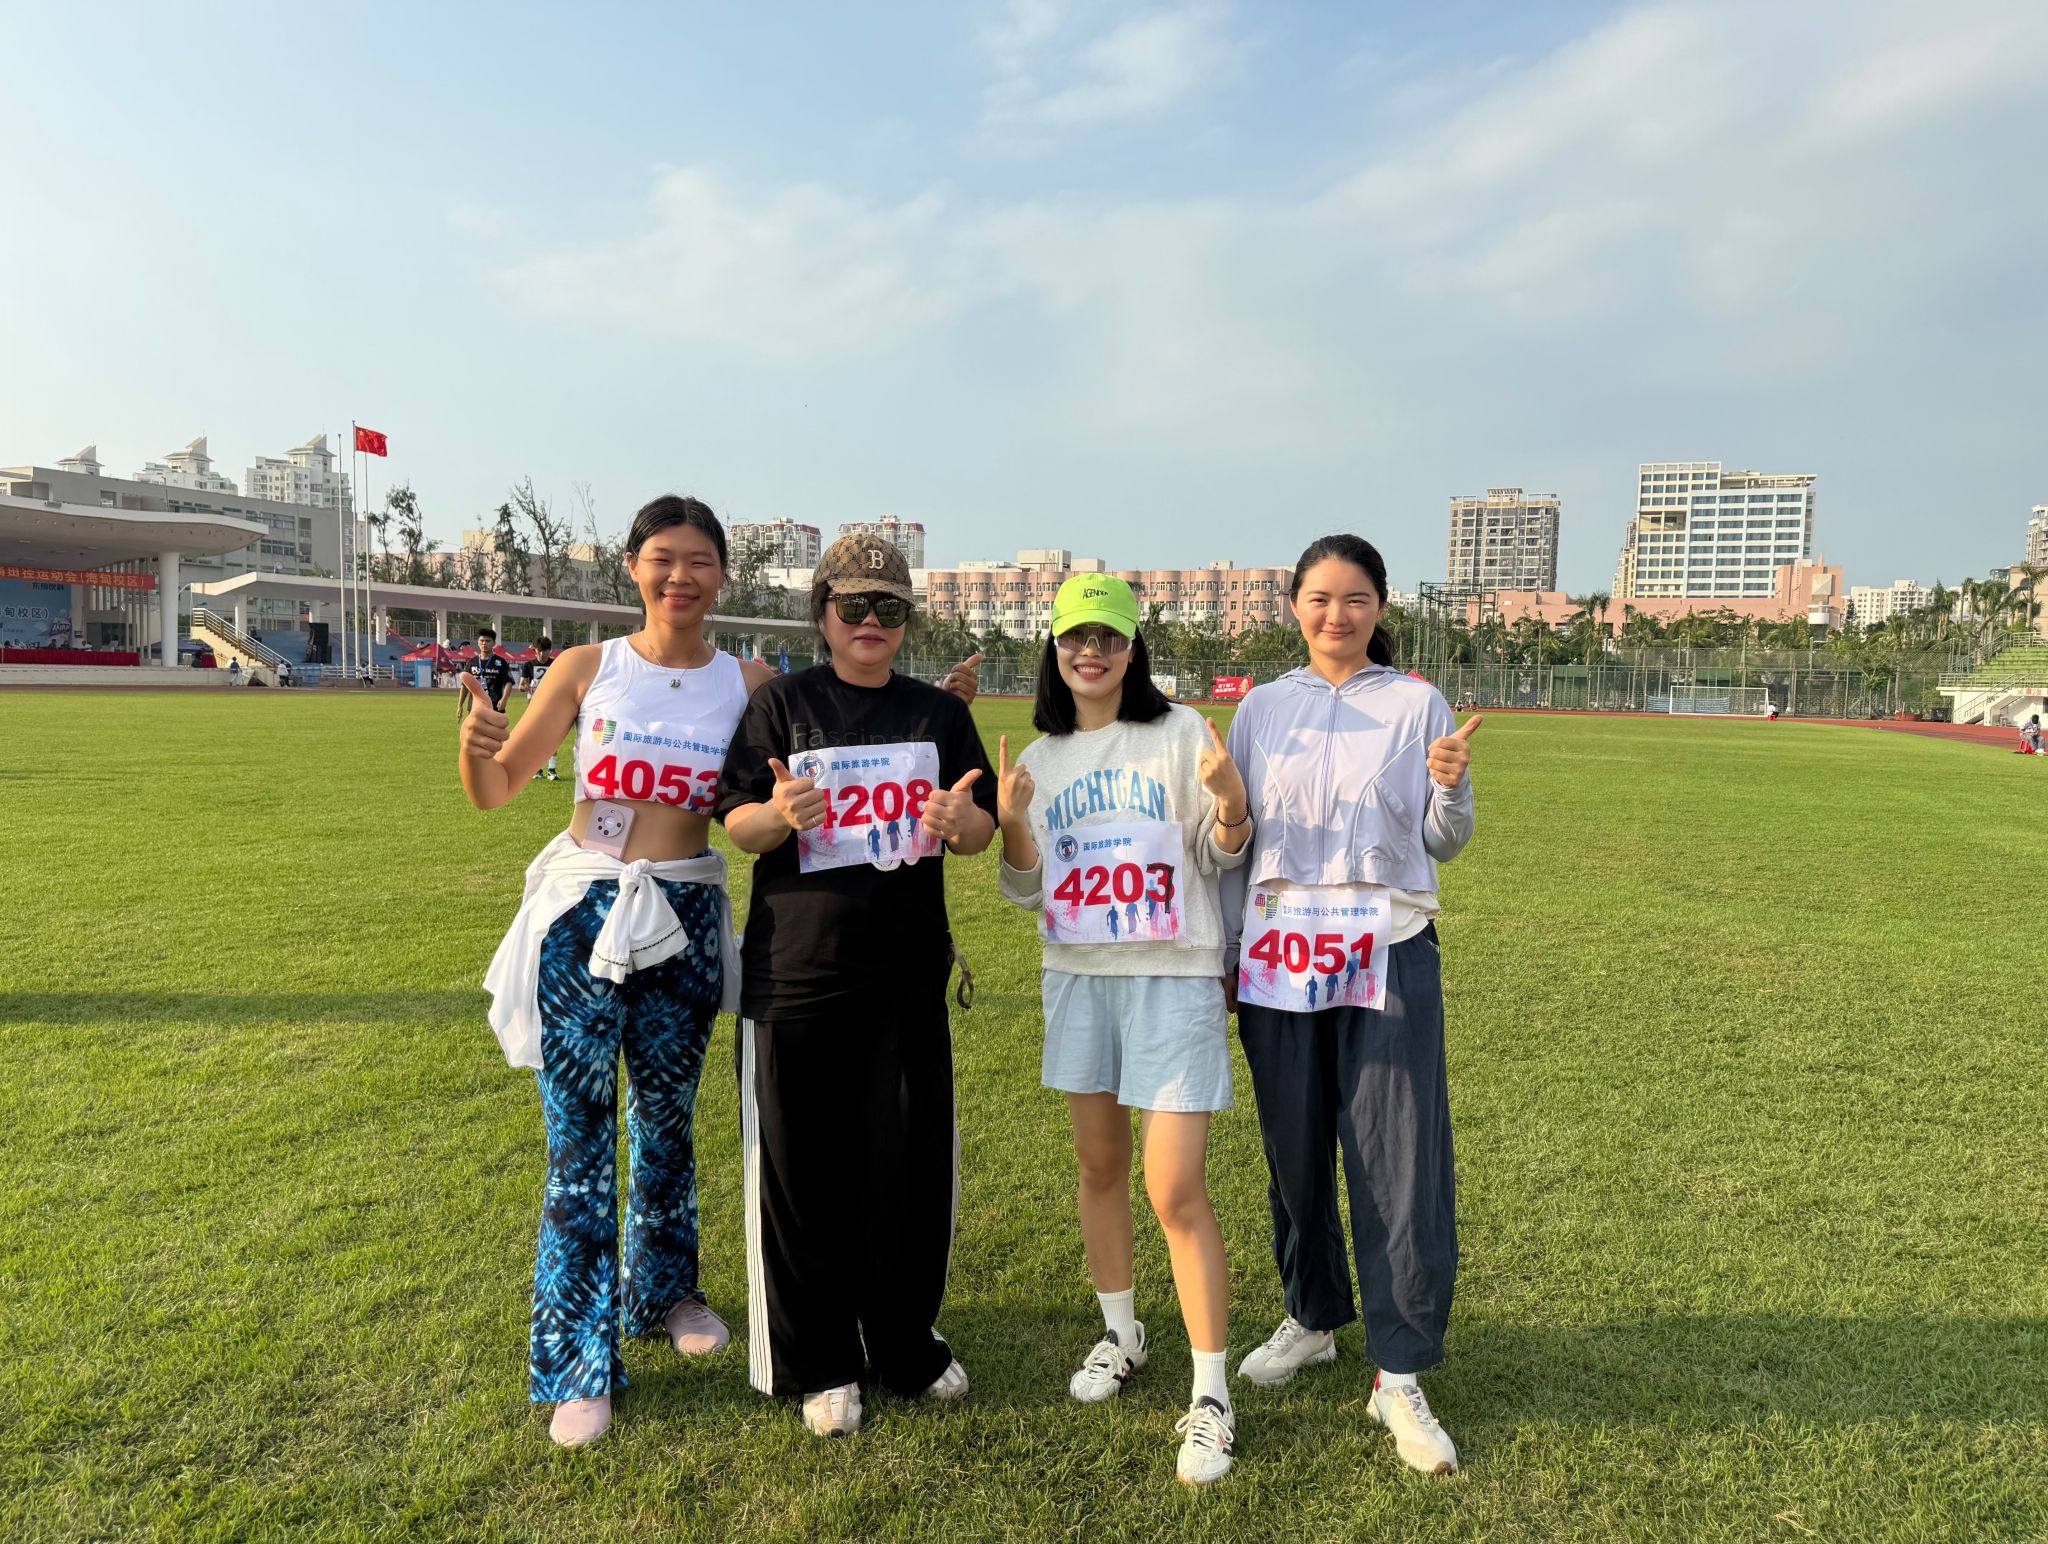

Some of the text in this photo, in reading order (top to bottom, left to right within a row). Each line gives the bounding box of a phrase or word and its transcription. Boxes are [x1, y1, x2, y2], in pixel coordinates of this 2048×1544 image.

[867, 549, 885, 570] B
[0, 607, 49, 619] 甸校区）
[623, 731, 728, 756] 国际旅游与公共管理学院
[831, 757, 891, 771] 国际旅游学院
[587, 754, 719, 808] 4053
[1045, 768, 1167, 831] MICHIGAN
[1083, 837, 1132, 851] 国际旅游学院
[1248, 928, 1375, 975] 4051
